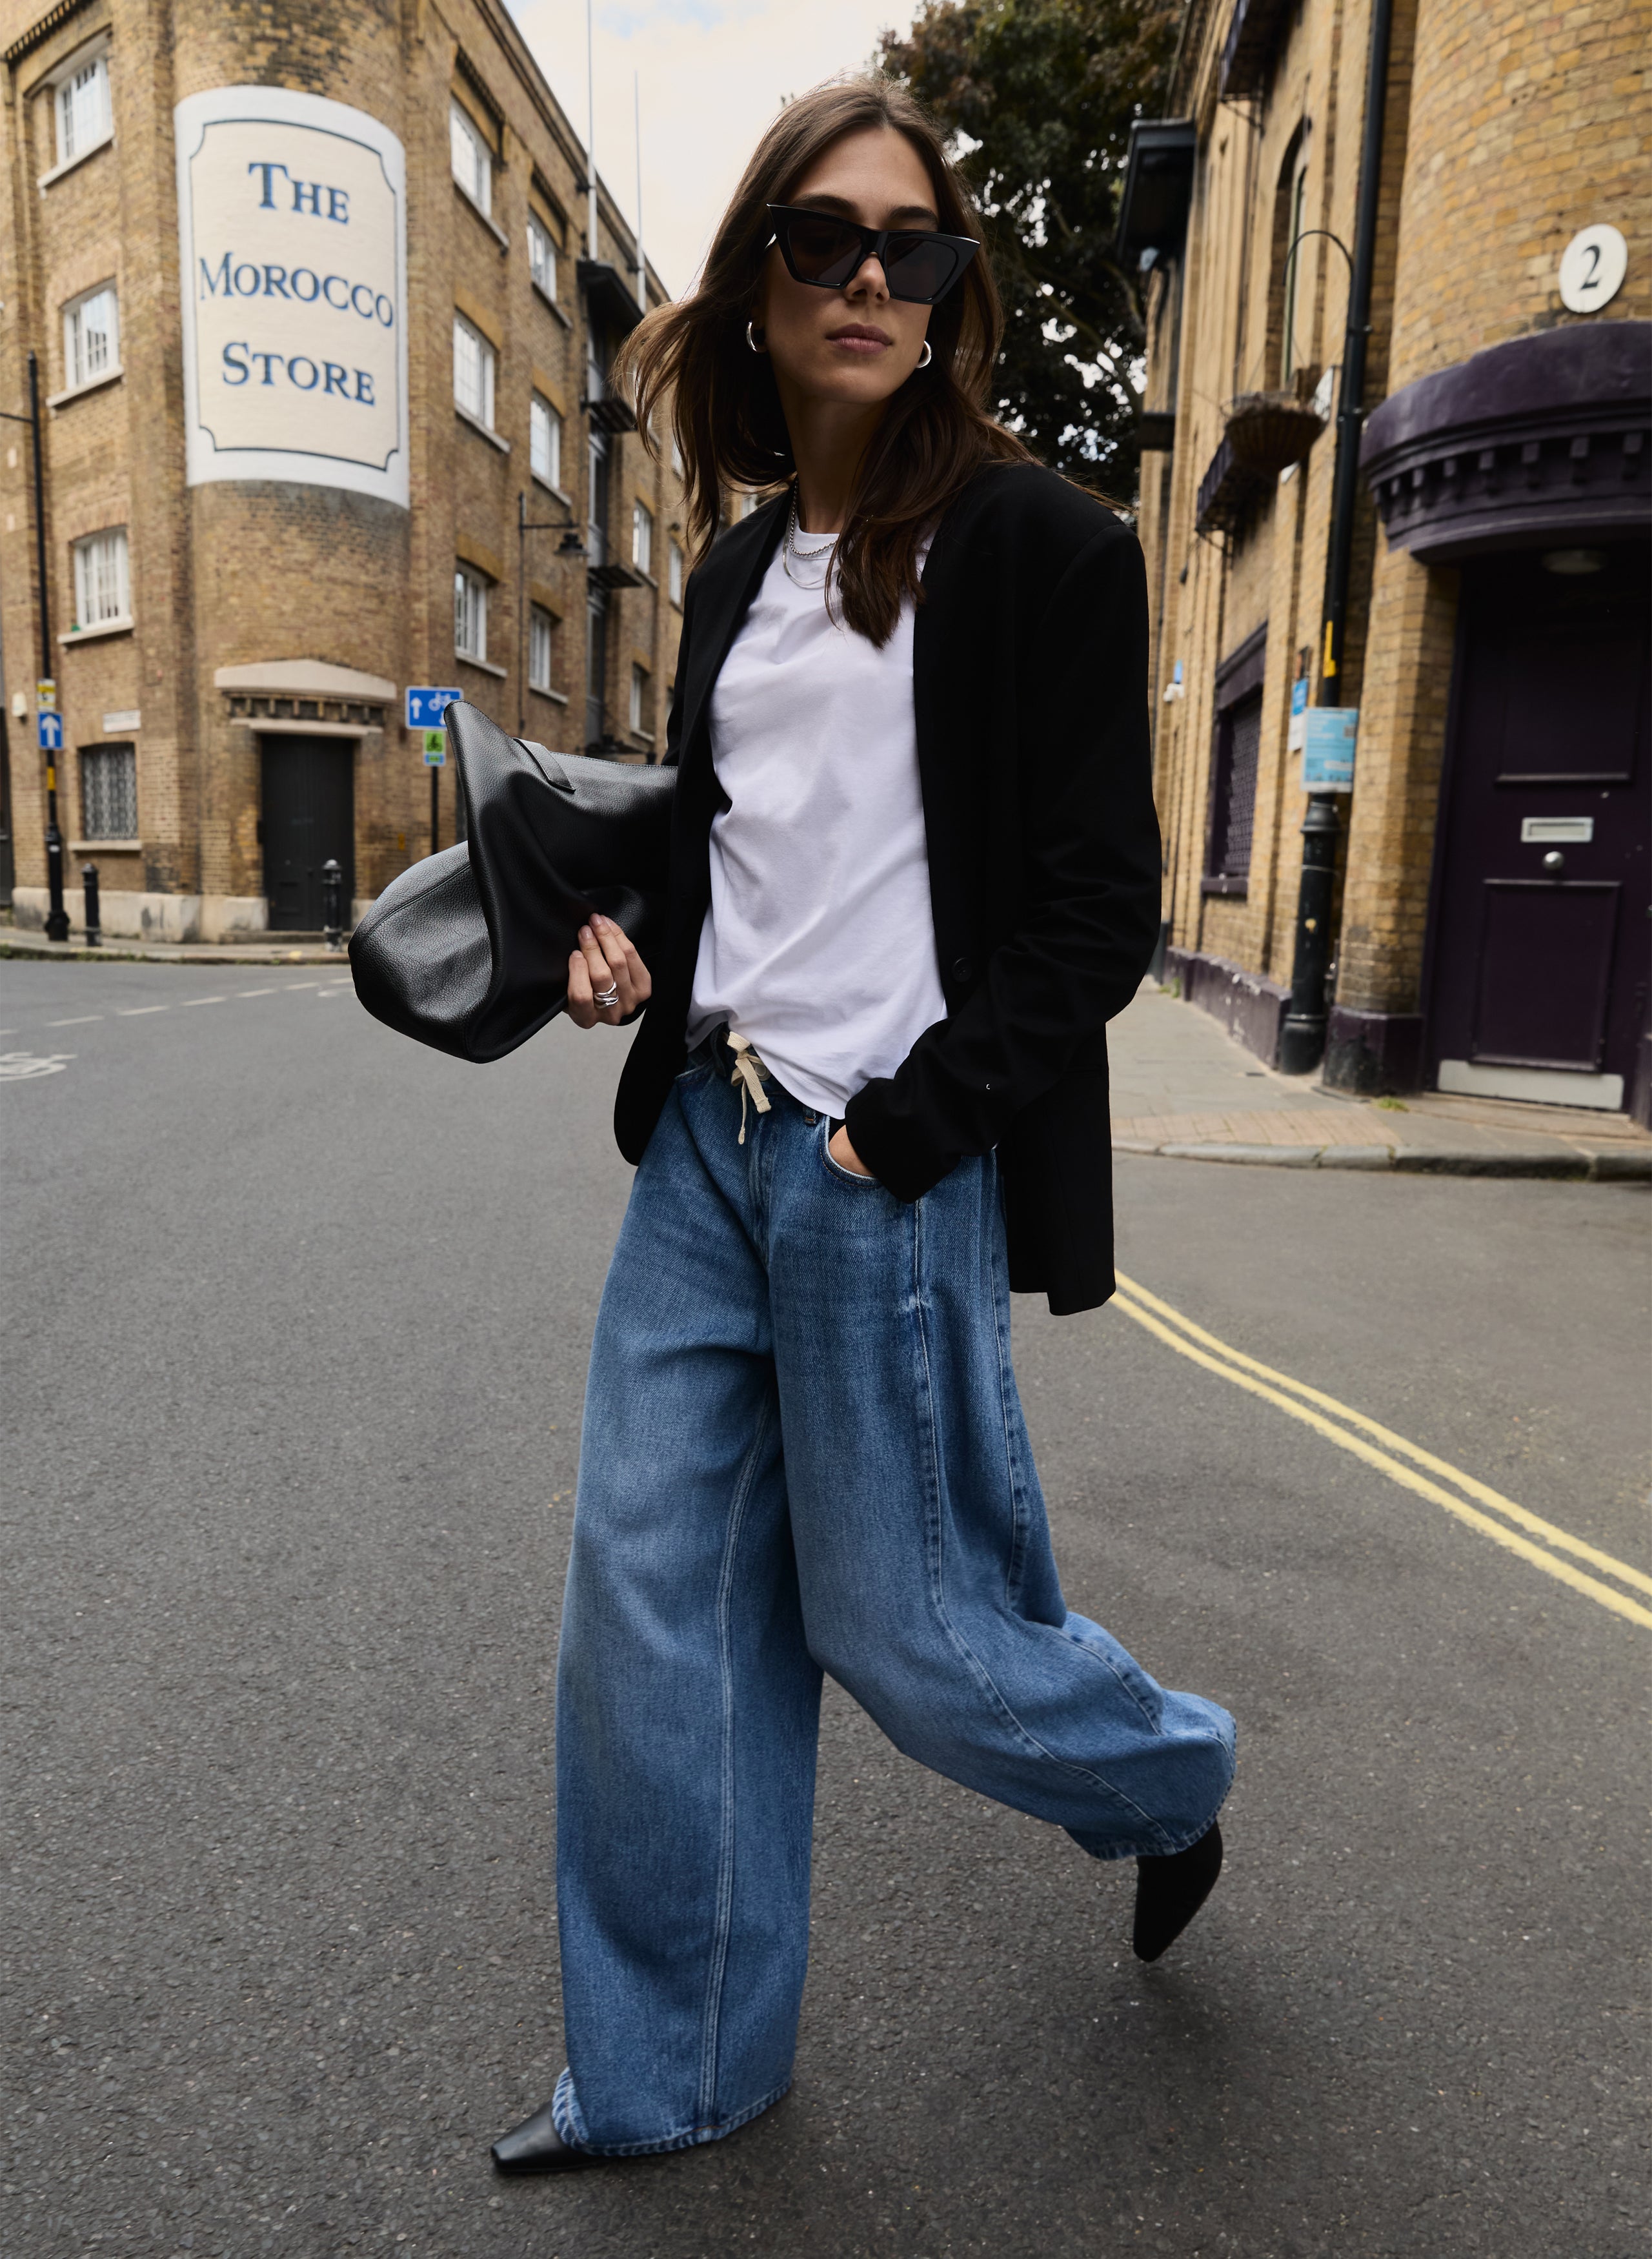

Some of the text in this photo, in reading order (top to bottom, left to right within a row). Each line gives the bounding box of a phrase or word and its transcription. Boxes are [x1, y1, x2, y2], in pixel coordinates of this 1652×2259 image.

[248, 161, 350, 224] THE
[199, 252, 394, 327] MOROCCO
[1580, 244, 1601, 290] 2
[222, 341, 376, 406] STORE
